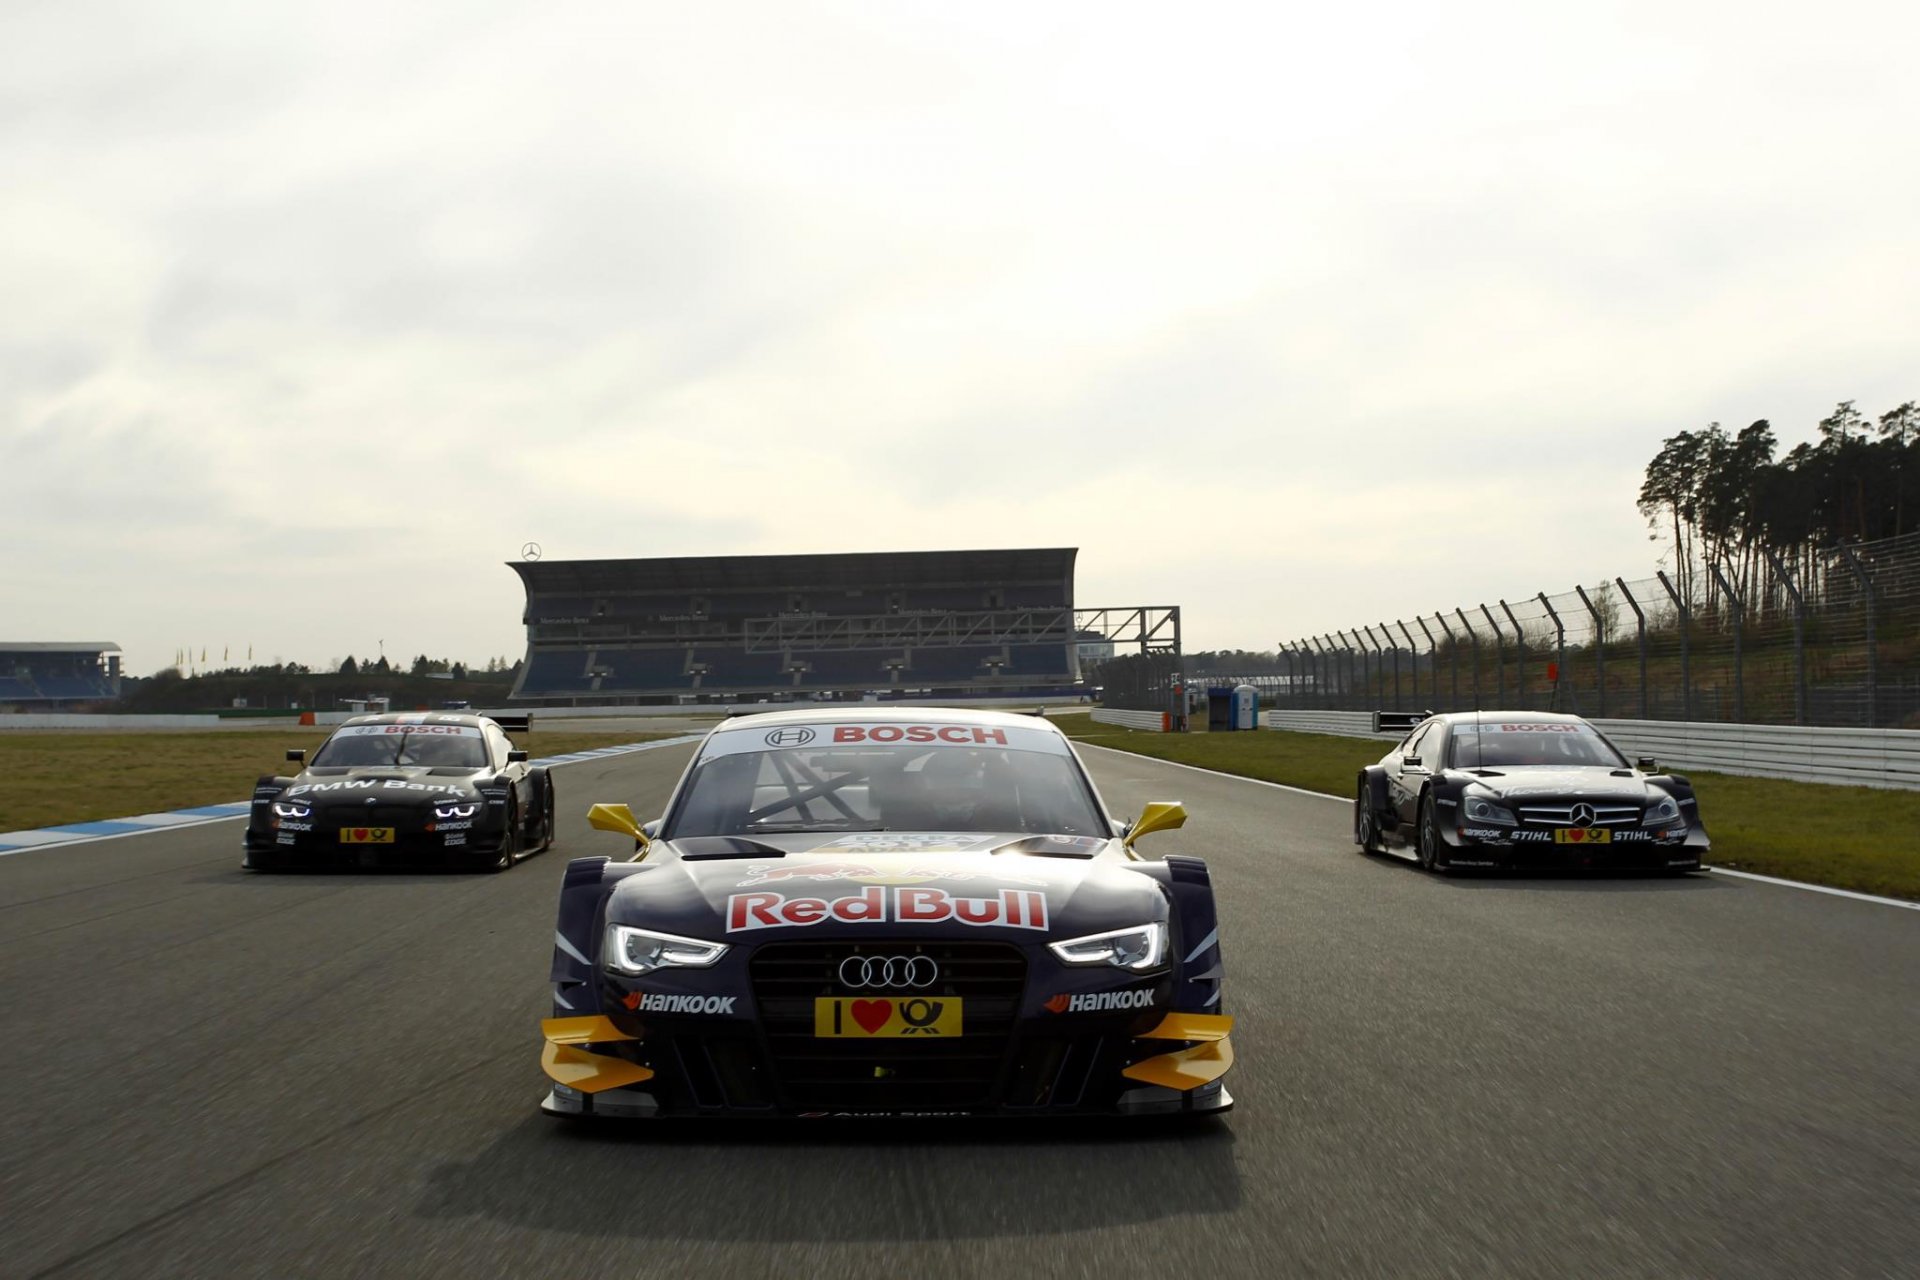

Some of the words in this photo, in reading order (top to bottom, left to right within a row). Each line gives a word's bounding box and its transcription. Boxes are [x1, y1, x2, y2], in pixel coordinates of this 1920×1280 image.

[384, 726, 462, 735] BOSCH
[1501, 724, 1579, 732] BOSCH
[833, 726, 1008, 745] BOSCH
[287, 779, 376, 798] BMW
[383, 779, 466, 797] Bank
[1510, 831, 1552, 841] STIHL
[1613, 831, 1652, 841] STIHL
[727, 886, 886, 933] Red
[895, 887, 1049, 931] Bull
